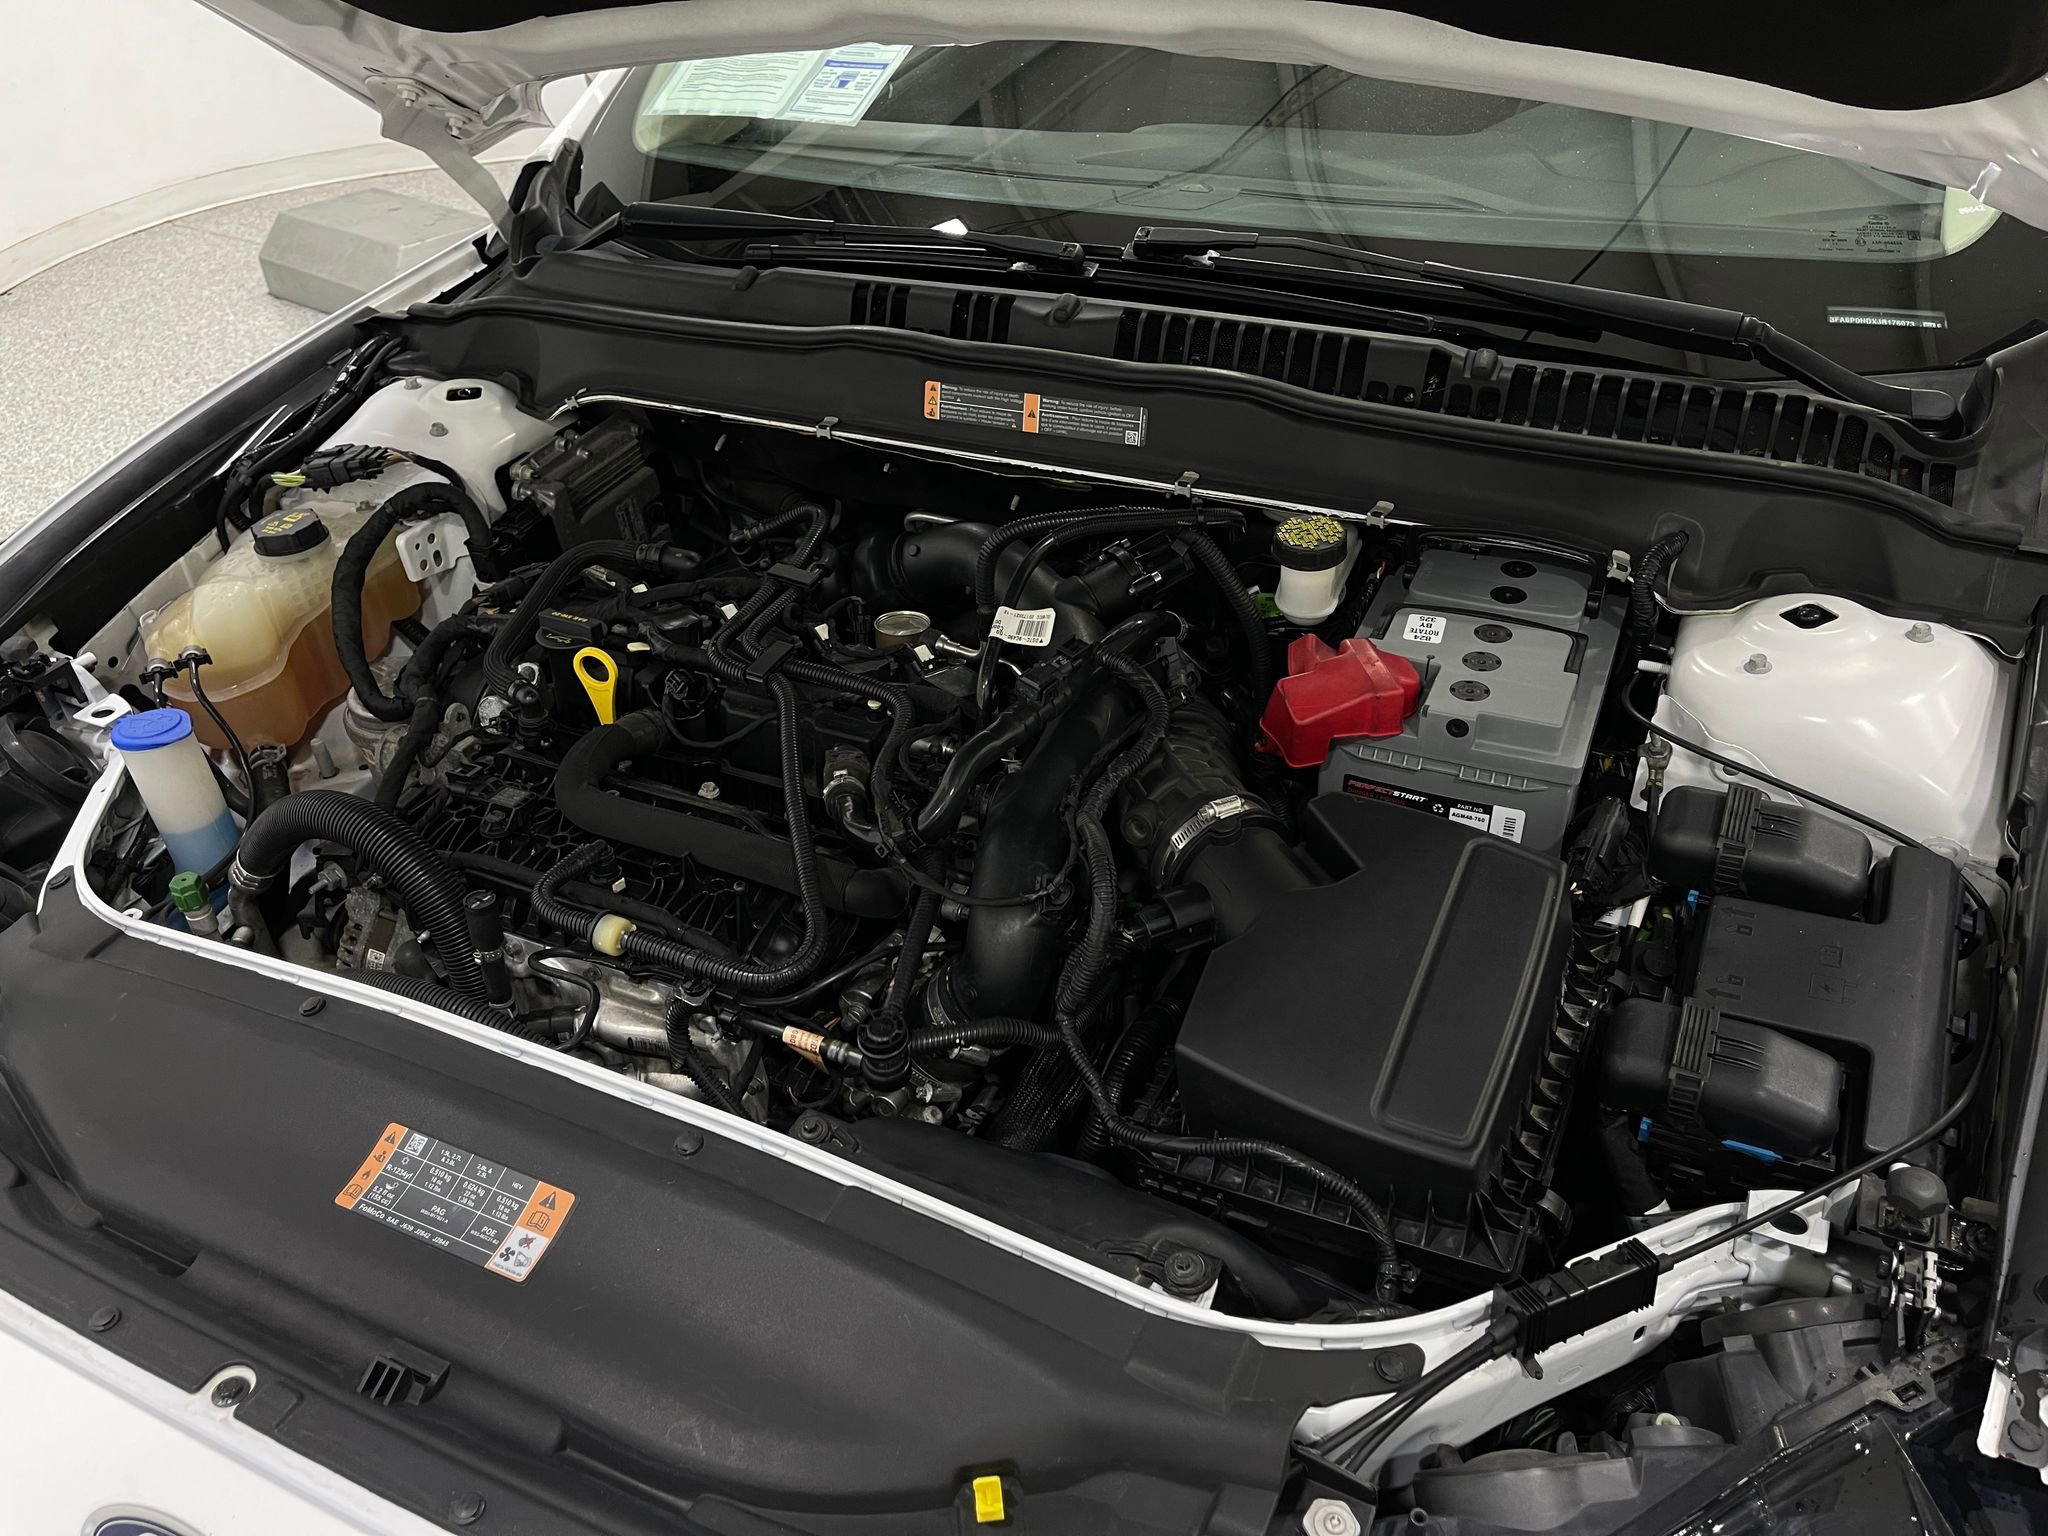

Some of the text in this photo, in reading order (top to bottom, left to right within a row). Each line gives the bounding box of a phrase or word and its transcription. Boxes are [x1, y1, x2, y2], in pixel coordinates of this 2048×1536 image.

[1410, 628, 1439, 636] ROTATE
[478, 1187, 486, 1197] kg
[430, 1205, 446, 1216] PAG
[511, 1201, 520, 1211] kg
[358, 1203, 385, 1219] FoMoCo
[386, 1216, 400, 1225] SAE
[481, 1226, 498, 1237] POE
